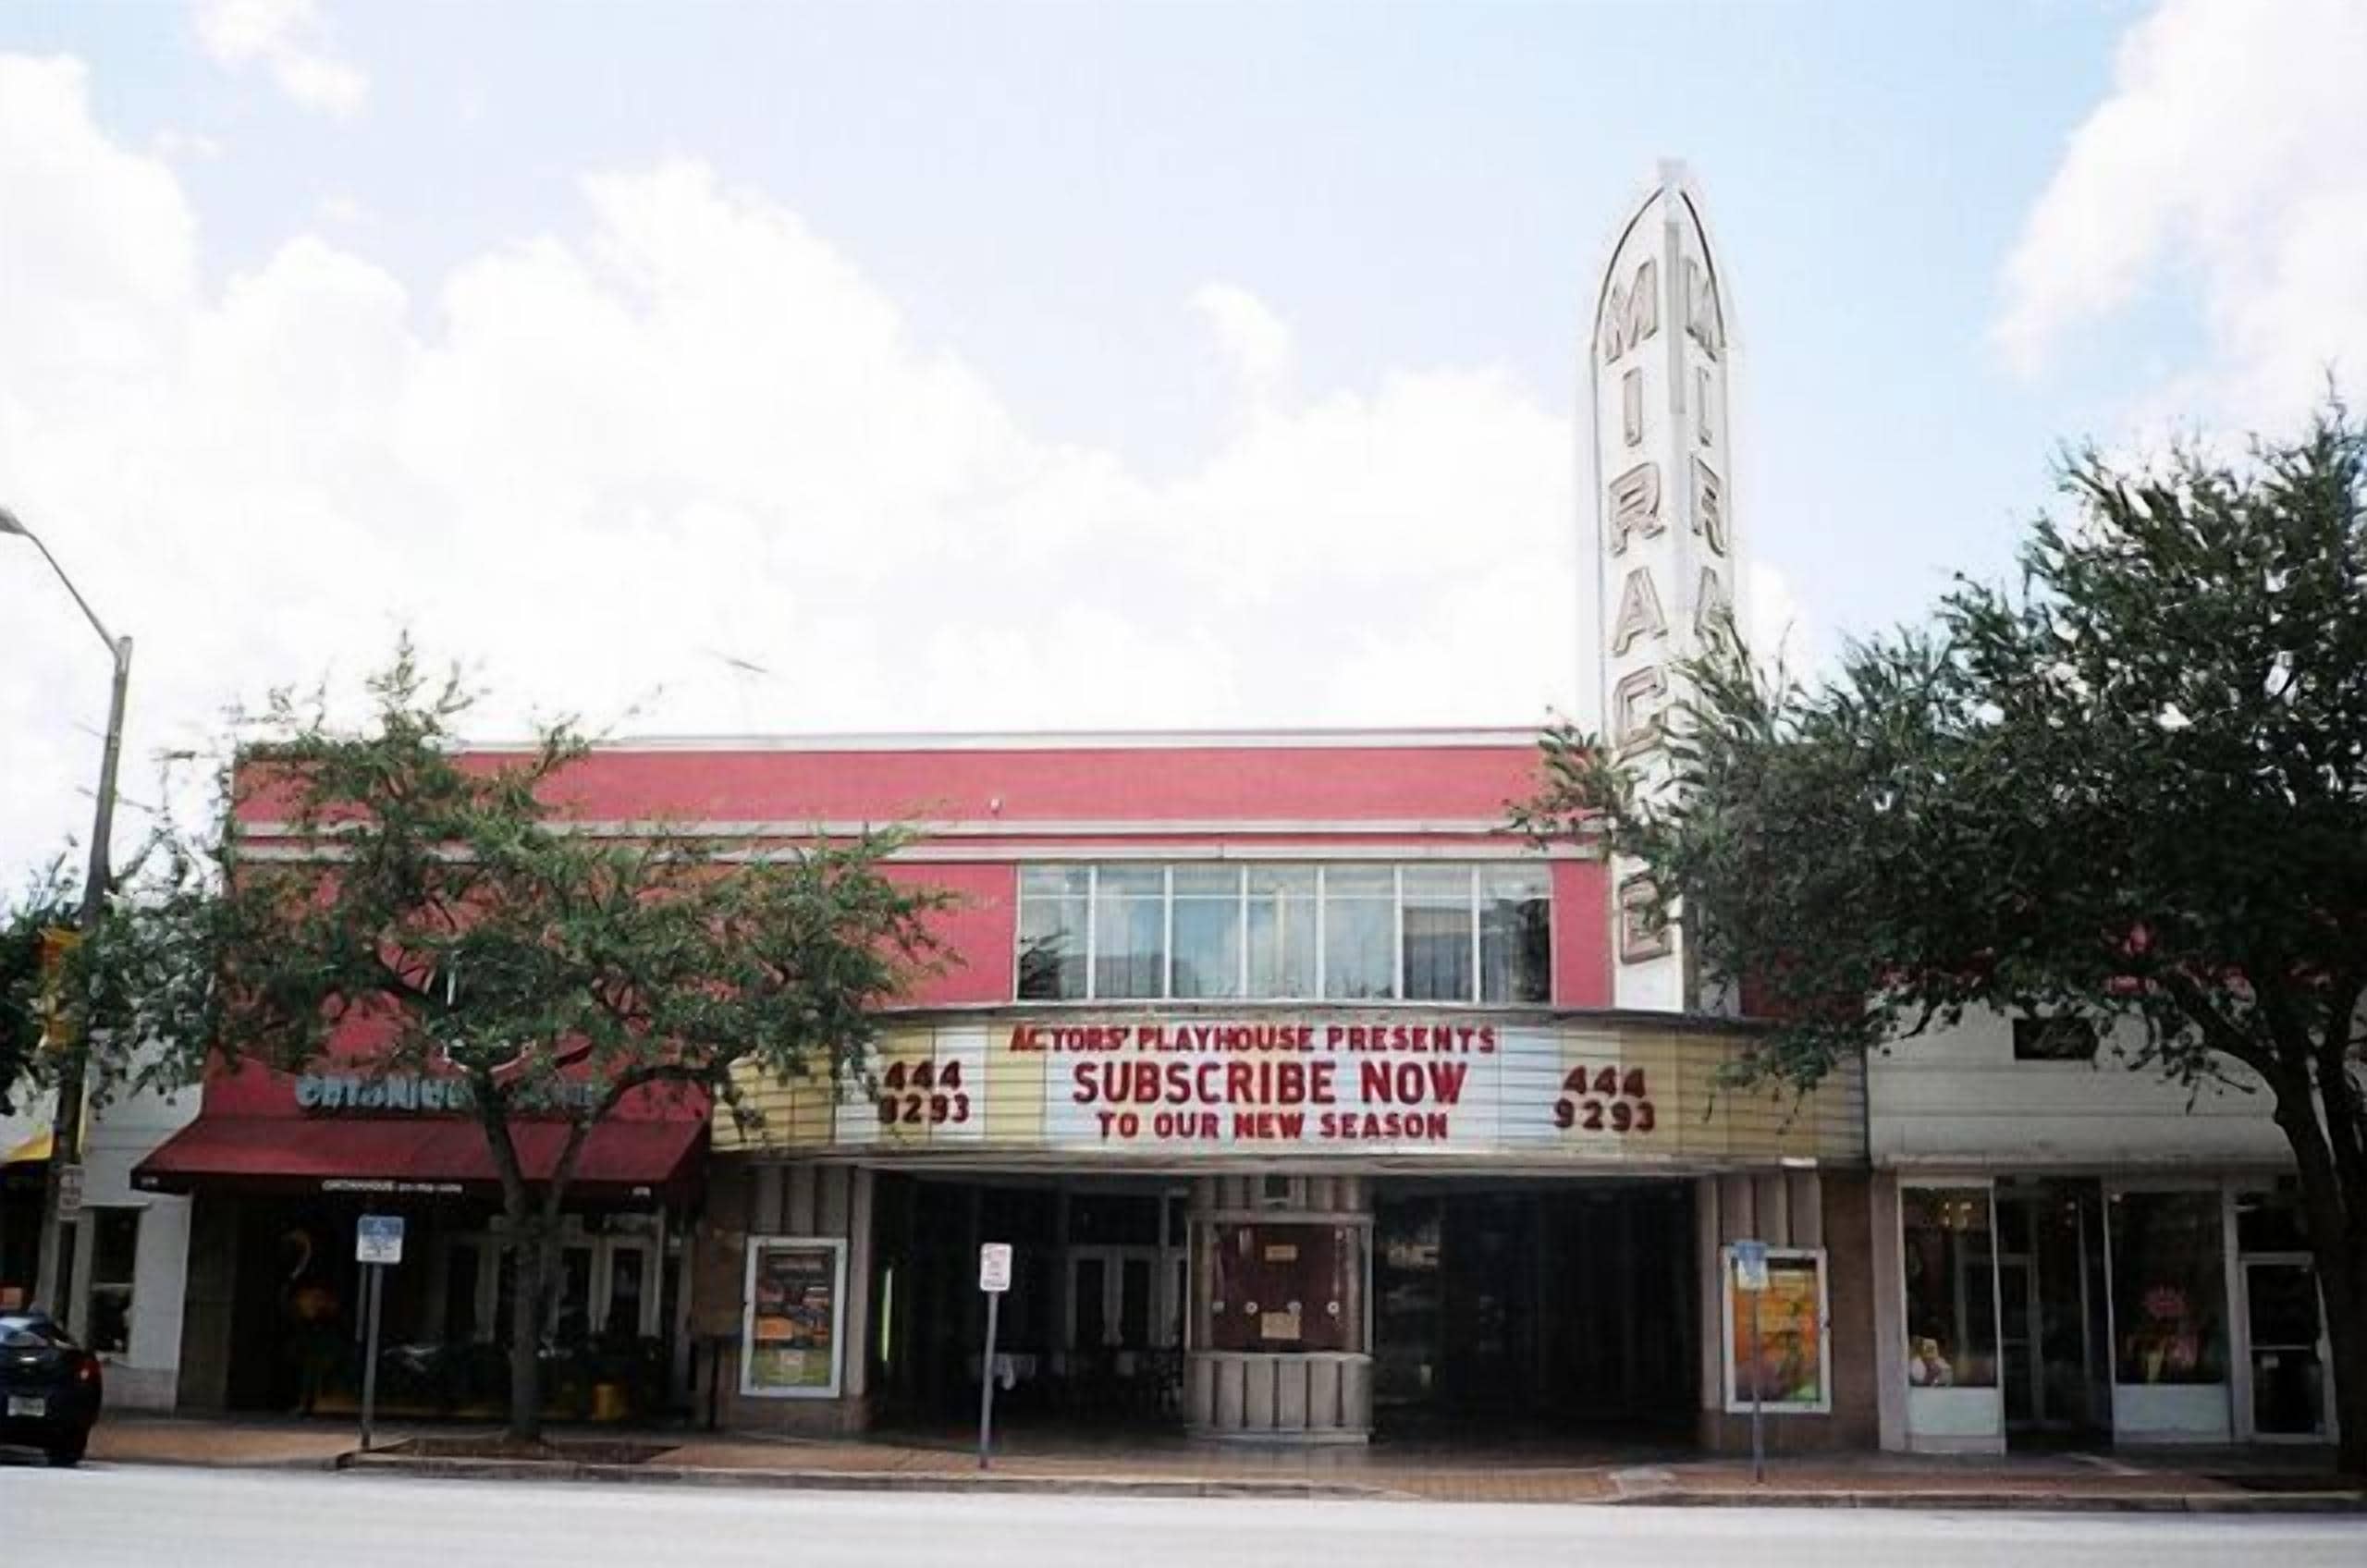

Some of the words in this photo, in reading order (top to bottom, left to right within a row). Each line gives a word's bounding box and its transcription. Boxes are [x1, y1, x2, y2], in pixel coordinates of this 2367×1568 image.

[1604, 256, 1671, 964] MIRACE
[1138, 1026, 1315, 1052] PLAYHOUSE
[1327, 1025, 1496, 1054] PRESENTS
[884, 1060, 962, 1092] 444
[1073, 1060, 1336, 1106] SUBSCRIBE
[1360, 1060, 1468, 1106] NOW
[1563, 1065, 1646, 1098] 444
[1097, 1111, 1139, 1140] TO
[1154, 1112, 1220, 1139] OUR
[1233, 1112, 1306, 1139] NEW
[1320, 1112, 1449, 1139] SEASON
[1552, 1097, 1656, 1133] 9293
